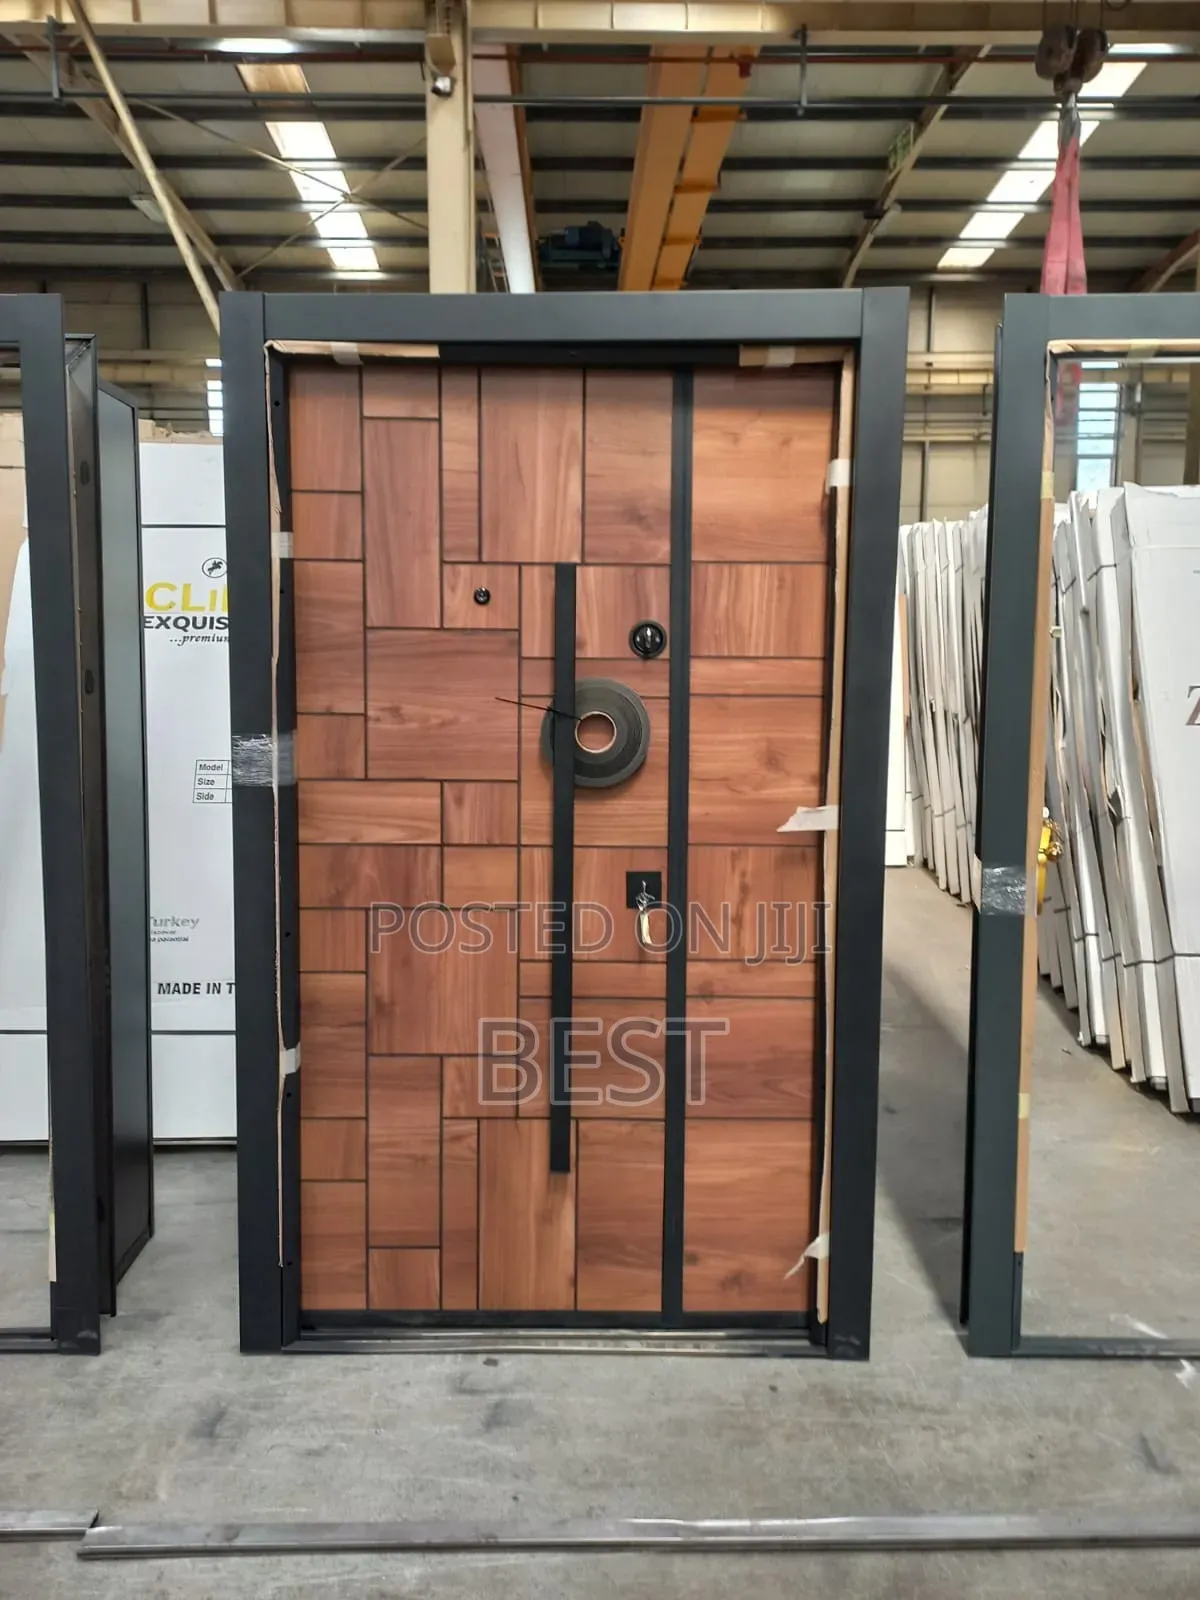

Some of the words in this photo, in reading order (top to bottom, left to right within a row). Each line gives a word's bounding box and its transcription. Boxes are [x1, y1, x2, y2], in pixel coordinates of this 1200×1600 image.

[144, 616, 229, 632] EXQUIS
[199, 763, 223, 771] Model
[197, 777, 215, 786] Size
[196, 792, 214, 801] Side
[158, 982, 201, 995] MADE
[206, 982, 221, 995] IN
